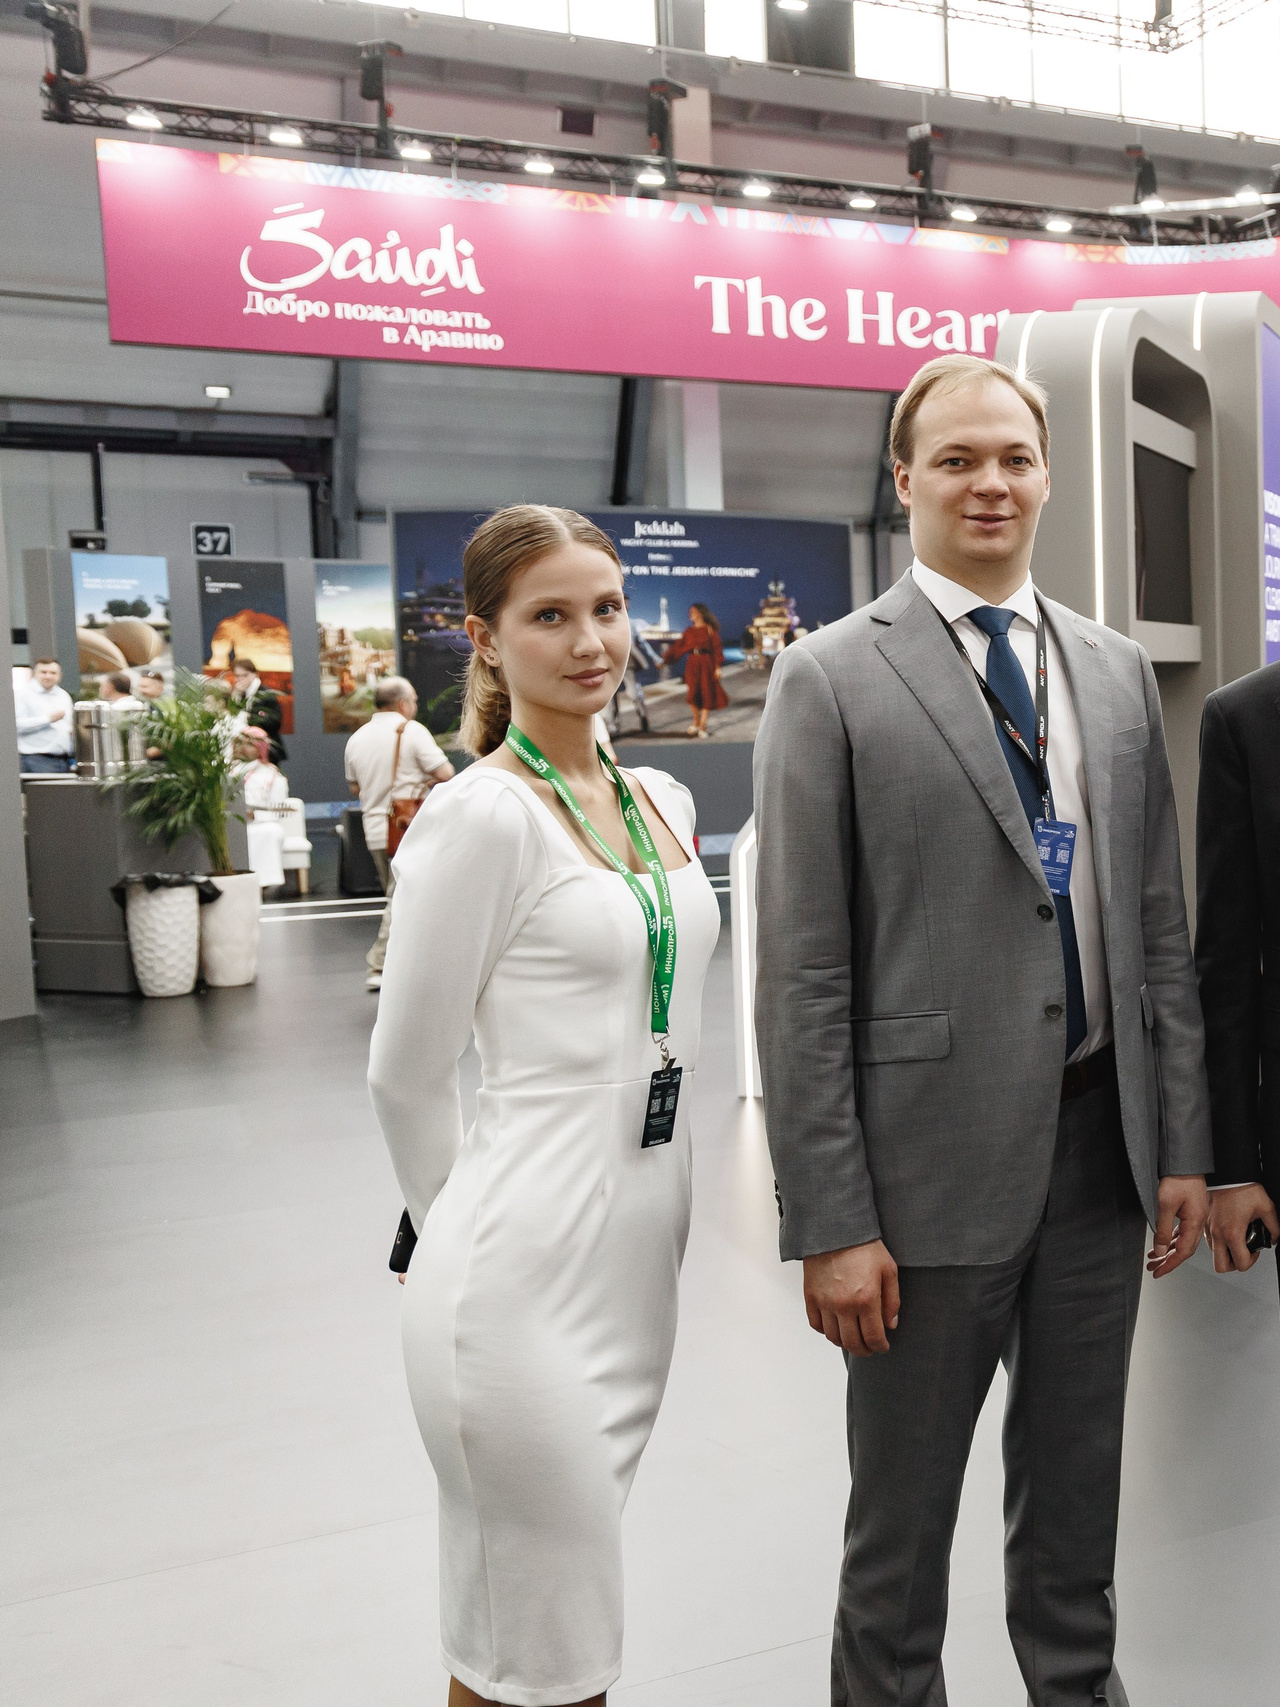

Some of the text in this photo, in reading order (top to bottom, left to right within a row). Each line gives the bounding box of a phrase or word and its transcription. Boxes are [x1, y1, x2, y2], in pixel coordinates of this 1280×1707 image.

[243, 291, 492, 330] Добро пожаловать
[694, 275, 827, 341] The
[382, 325, 504, 352] в Аравию
[196, 531, 229, 553] 37
[634, 520, 686, 538] Jeddah
[632, 565, 649, 575] ON
[650, 565, 670, 576] THE
[671, 566, 709, 576] JEDDAH
[507, 736, 542, 770] ИННОПРОМ
[550, 778, 582, 817] INNOPROM
[630, 807, 653, 853] ИННОПРОМ
[655, 862, 670, 906] INNOPROM
[631, 883, 654, 930] INNOPROM
[665, 921, 676, 974] ИННОПРОМ
